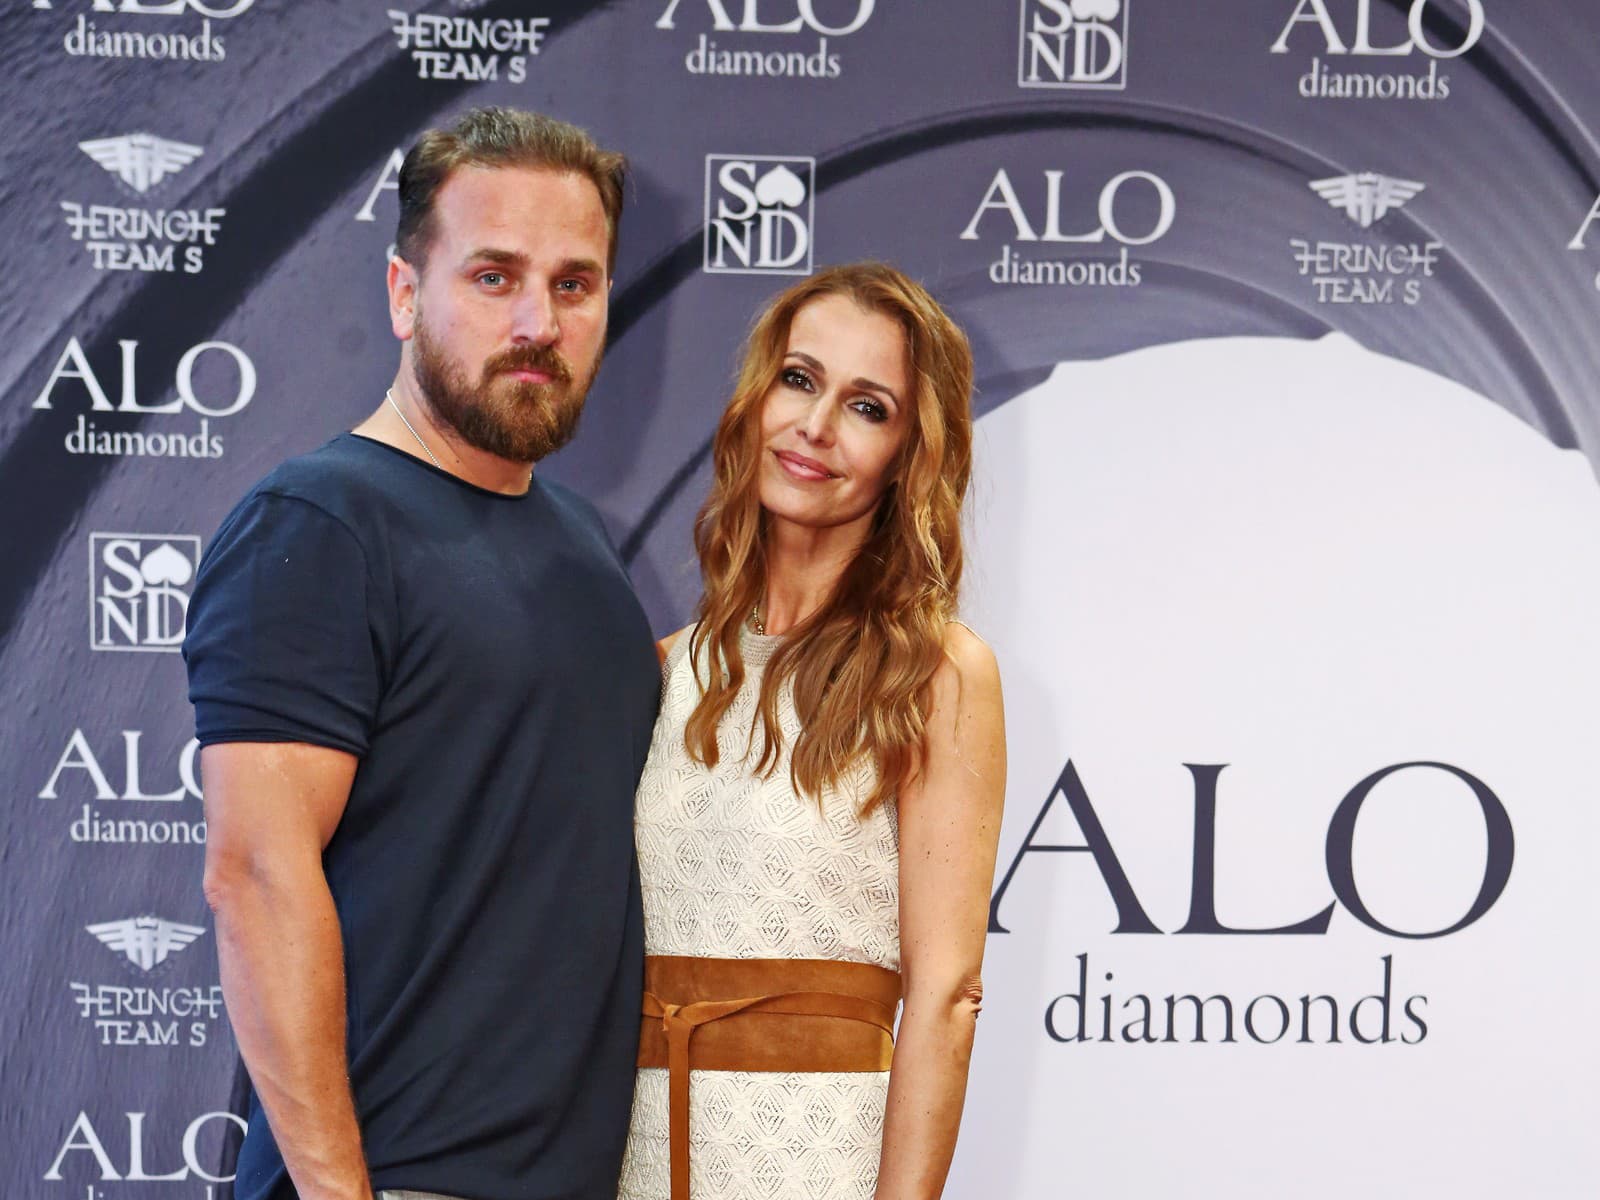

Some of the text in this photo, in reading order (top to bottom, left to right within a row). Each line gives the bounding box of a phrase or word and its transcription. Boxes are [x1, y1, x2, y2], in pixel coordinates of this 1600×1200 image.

[64, 13, 226, 61] diamonds
[1270, 0, 1485, 57] ALO
[412, 51, 526, 83] TEAM S
[685, 33, 841, 78] diamonds
[1300, 58, 1450, 99] diamonds
[960, 168, 1176, 245] ALO
[88, 242, 203, 273] TEAM S
[989, 245, 1142, 286] diamonds
[1313, 277, 1421, 305] TEAM S
[33, 336, 257, 416] ALO
[65, 415, 224, 458] diamonds
[70, 804, 207, 843] diamond
[987, 757, 1515, 940] ALO
[1045, 952, 1429, 1045] diamonds
[95, 1020, 206, 1047] TEAM S
[44, 1111, 249, 1182] ALO
